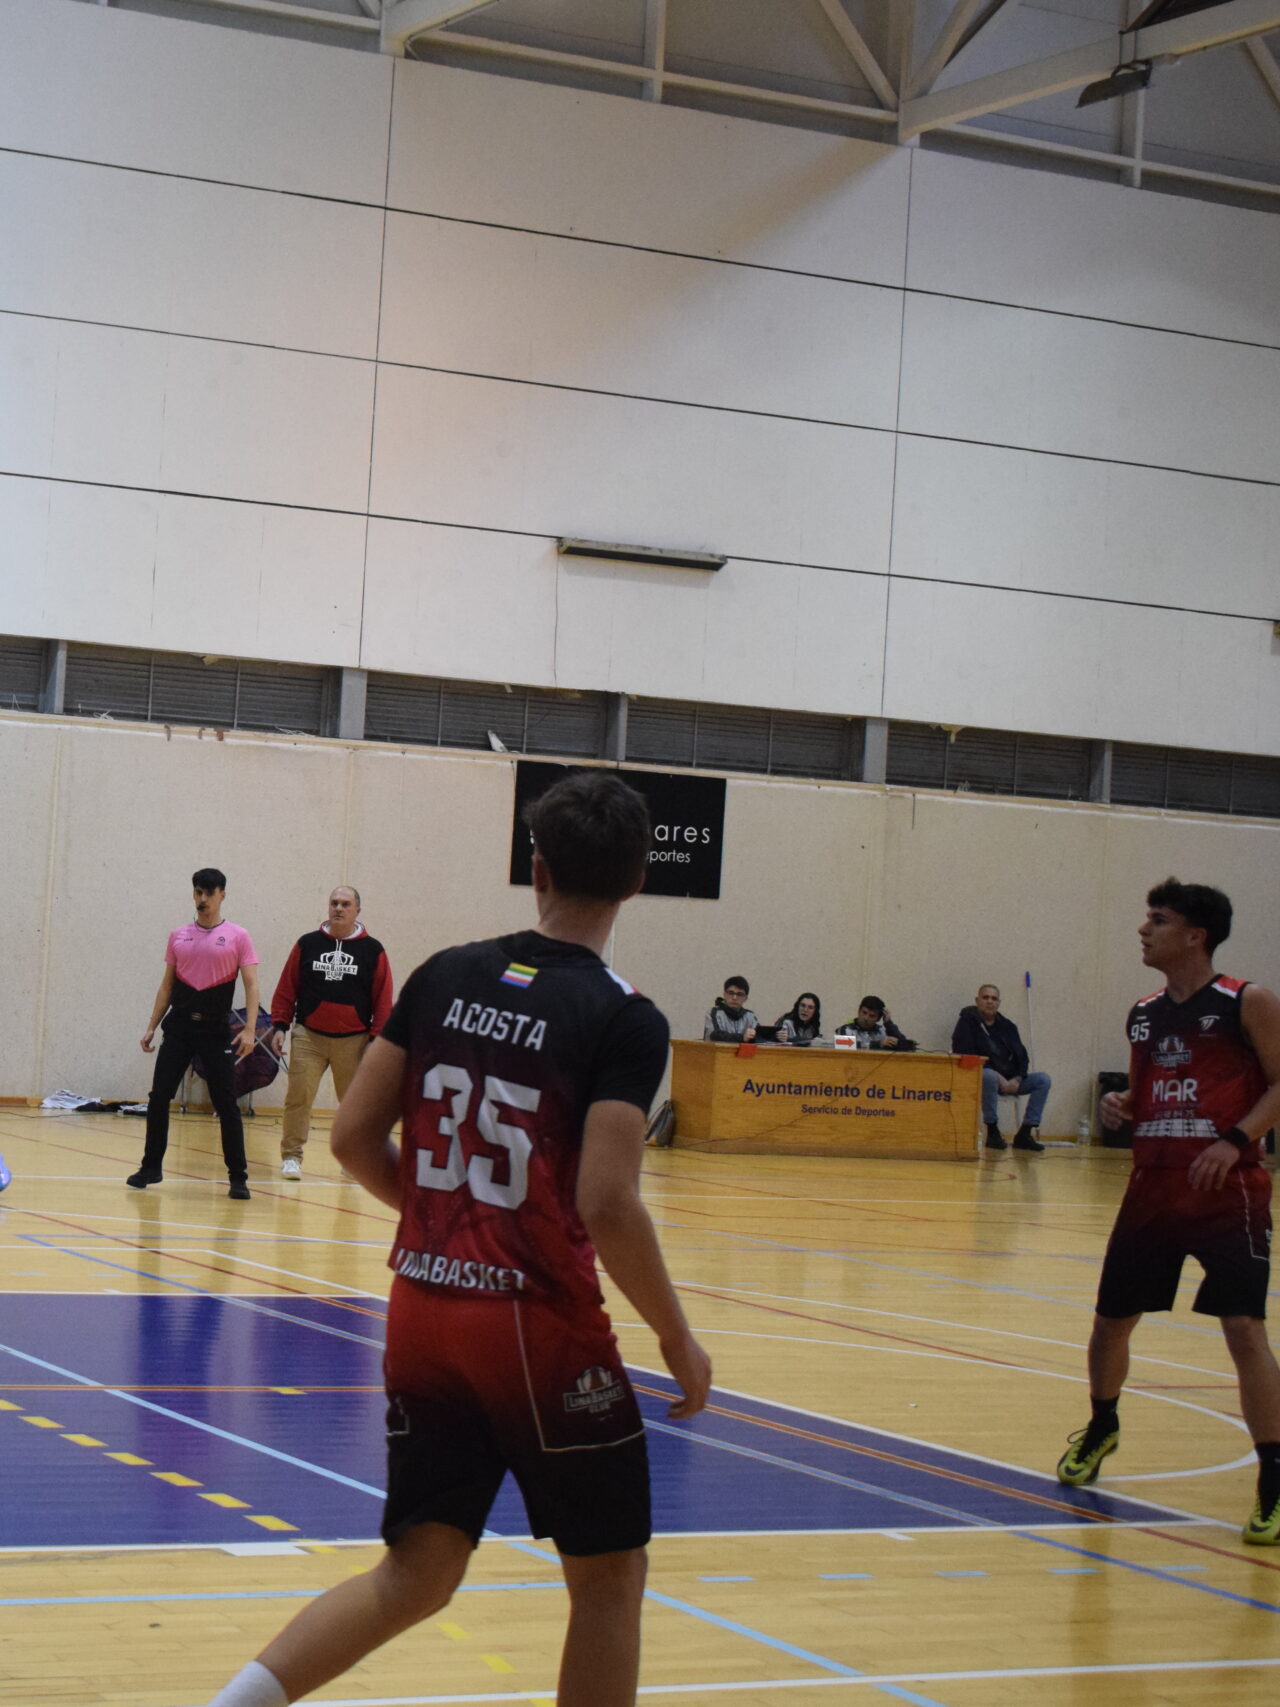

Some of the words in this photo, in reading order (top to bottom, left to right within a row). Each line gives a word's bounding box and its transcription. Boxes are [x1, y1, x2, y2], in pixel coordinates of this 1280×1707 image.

[443, 998, 547, 1050] ACOSTA
[1131, 1022, 1150, 1043] 95
[742, 1079, 860, 1098] Ayuntamiento
[866, 1084, 886, 1099] de
[891, 1086, 952, 1102] Linares
[1152, 1078, 1198, 1103] MAR
[801, 1104, 838, 1115] Servicio
[842, 1106, 852, 1115] de
[855, 1106, 895, 1118] Deportes
[416, 1063, 541, 1210] 35
